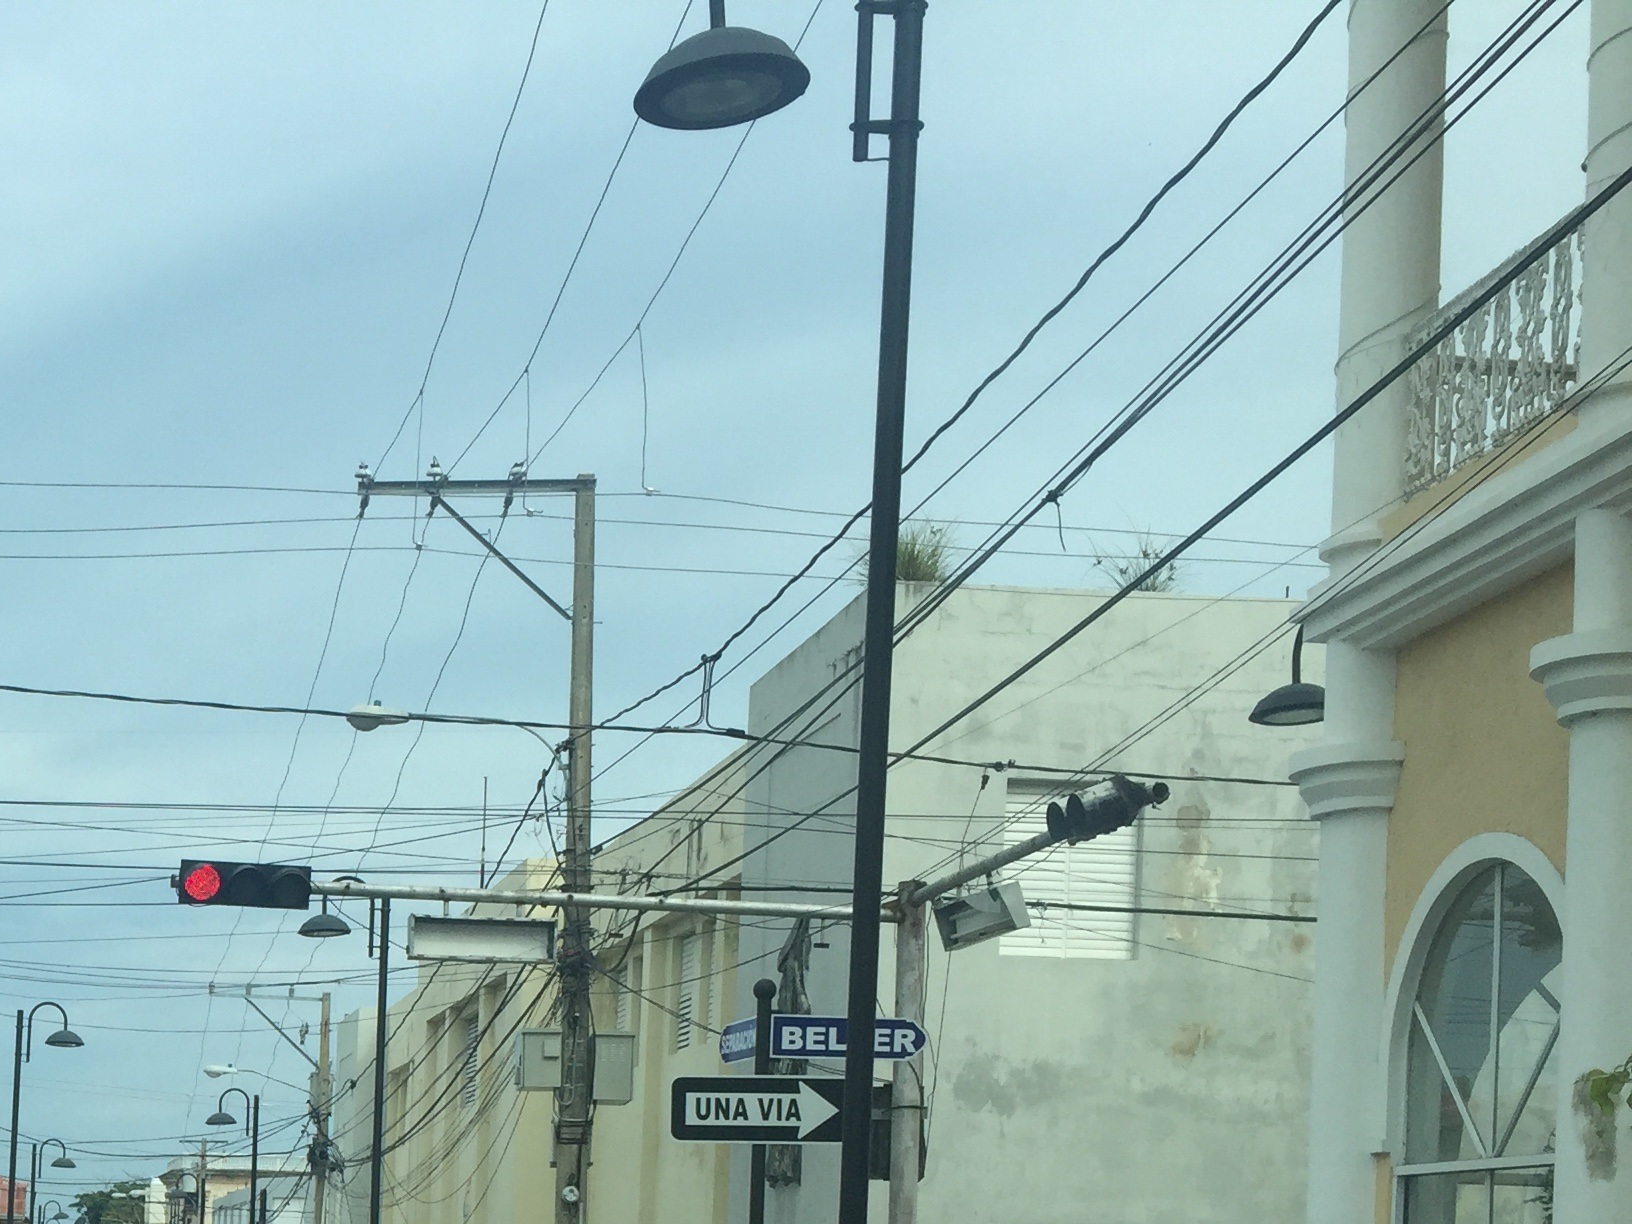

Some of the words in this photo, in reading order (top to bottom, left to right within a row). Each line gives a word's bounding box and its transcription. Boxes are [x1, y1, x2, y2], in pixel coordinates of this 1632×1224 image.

[781, 1026, 916, 1053] BELER
[695, 1097, 749, 1121] UNA
[757, 1097, 802, 1122] VIA
